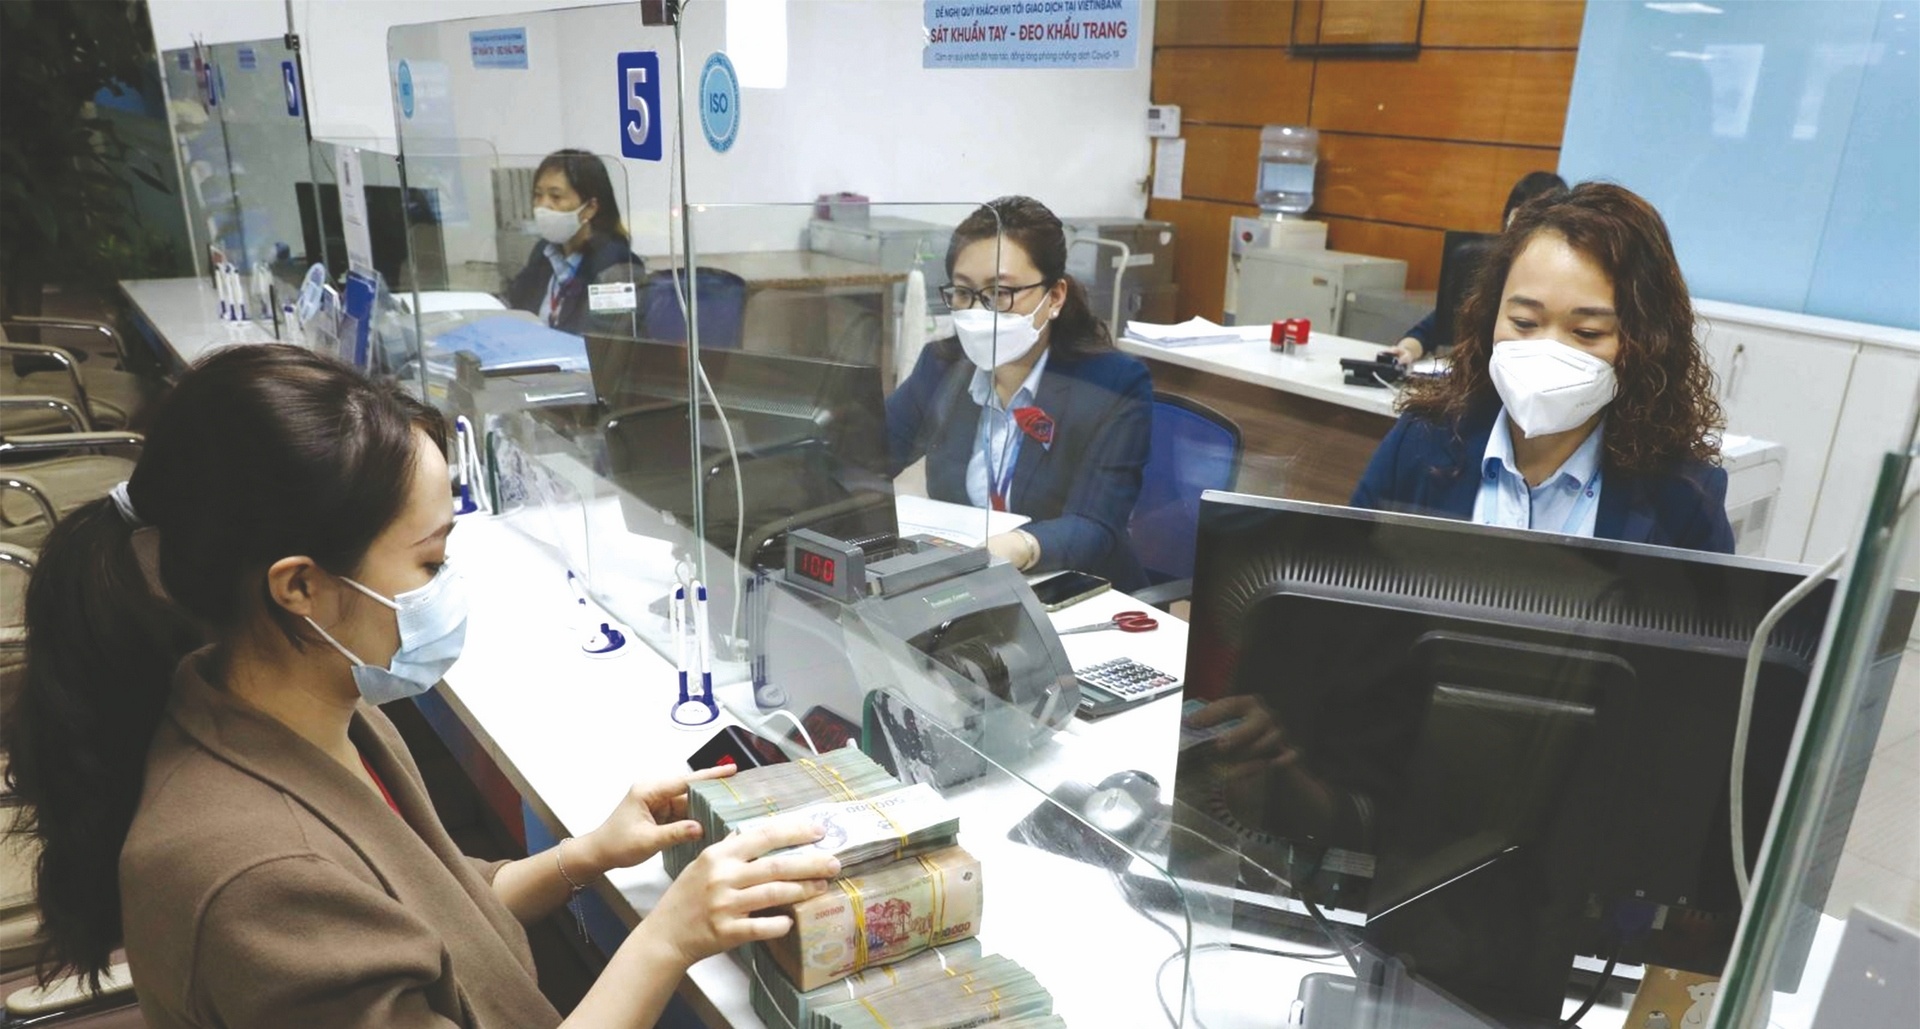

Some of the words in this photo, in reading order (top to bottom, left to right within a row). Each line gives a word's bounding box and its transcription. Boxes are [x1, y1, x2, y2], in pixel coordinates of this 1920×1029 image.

[945, 7, 960, 19] NGHỊ
[976, 3, 999, 16] KHÁCH
[1000, 4, 1011, 15] KHI
[1025, 2, 1043, 14] GIAO
[1045, 1, 1063, 14] DỊCH
[1065, 0, 1076, 14] TẠI
[1077, 0, 1122, 11] VIETINBANK
[930, 24, 949, 43] SÁT
[950, 19, 986, 42] KHUẨN
[988, 25, 1008, 42] TAY
[1019, 24, 1044, 40] ĐEO
[1046, 16, 1080, 40] KHẨU
[1082, 20, 1127, 39] TRANG
[626, 67, 650, 146] 5
[709, 92, 729, 114] ISO
[802, 551, 834, 583] 100
